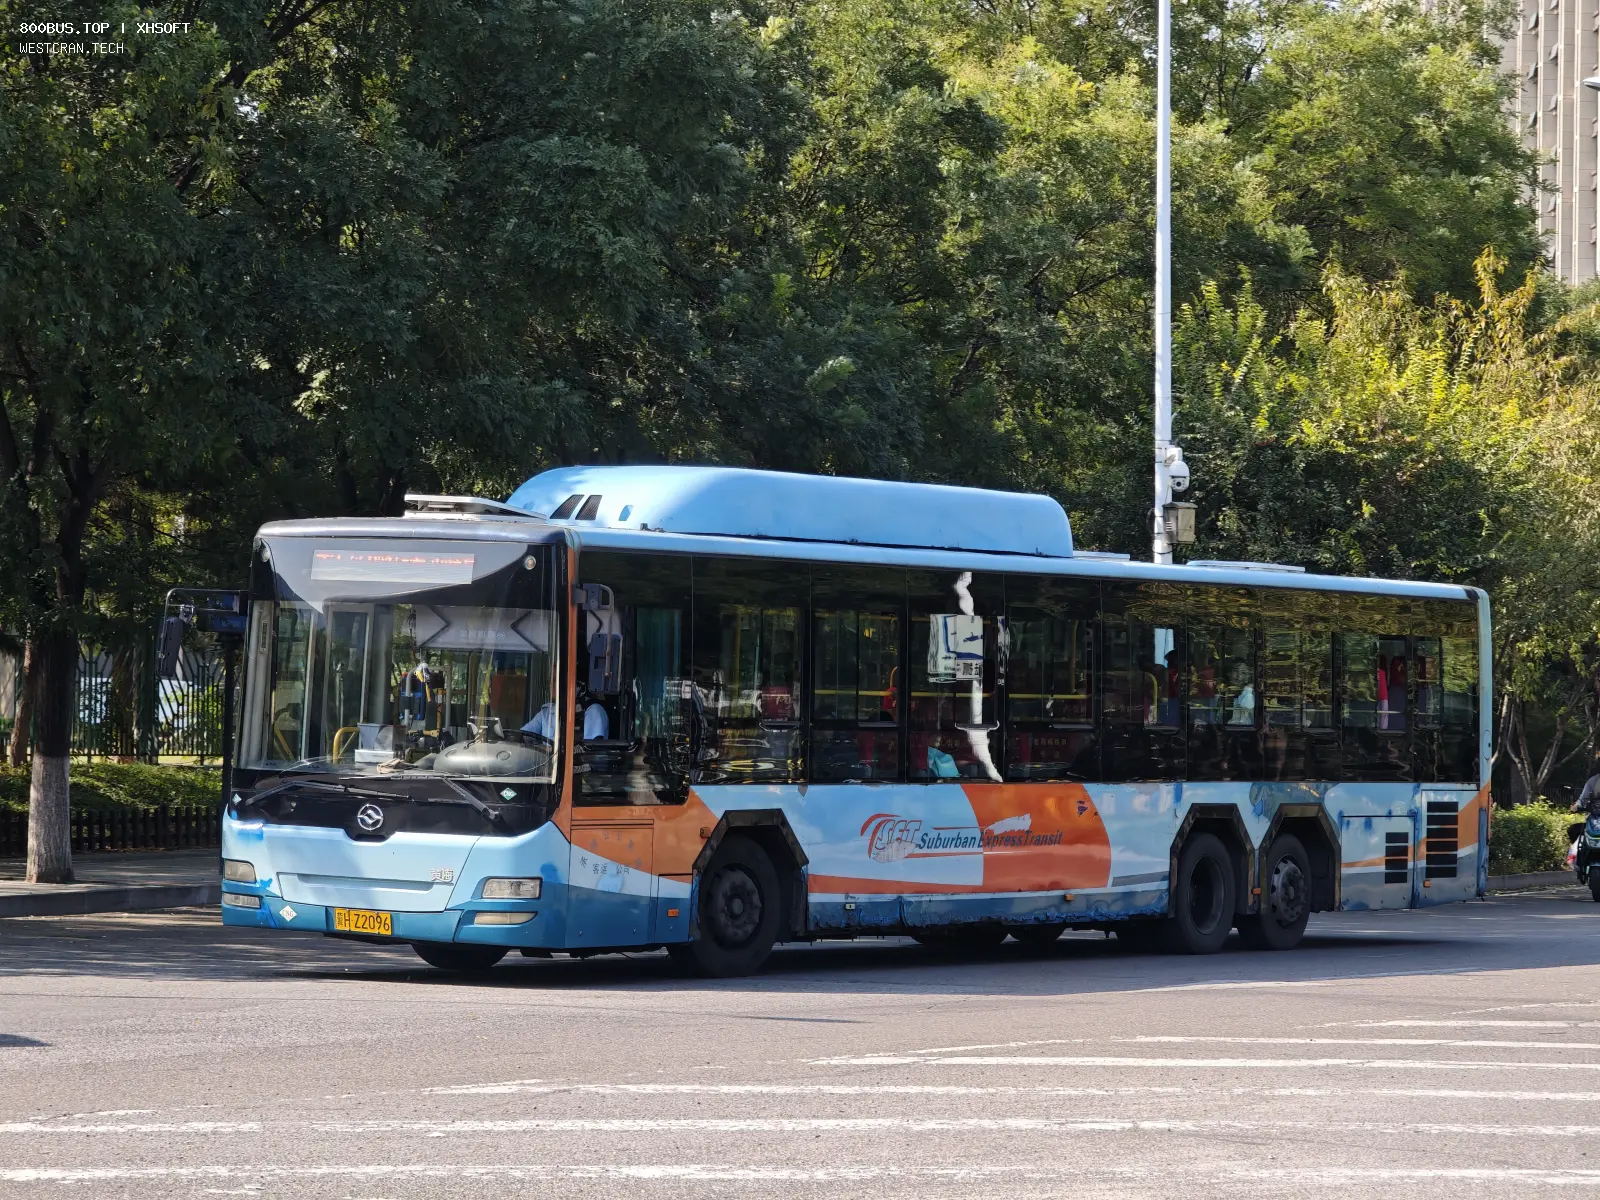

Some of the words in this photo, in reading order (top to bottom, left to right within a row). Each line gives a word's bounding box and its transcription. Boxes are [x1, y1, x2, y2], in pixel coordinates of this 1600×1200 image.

[918, 831, 976, 850] Suburban
[977, 831, 1022, 850] Express
[1023, 828, 1064, 847] Transit
